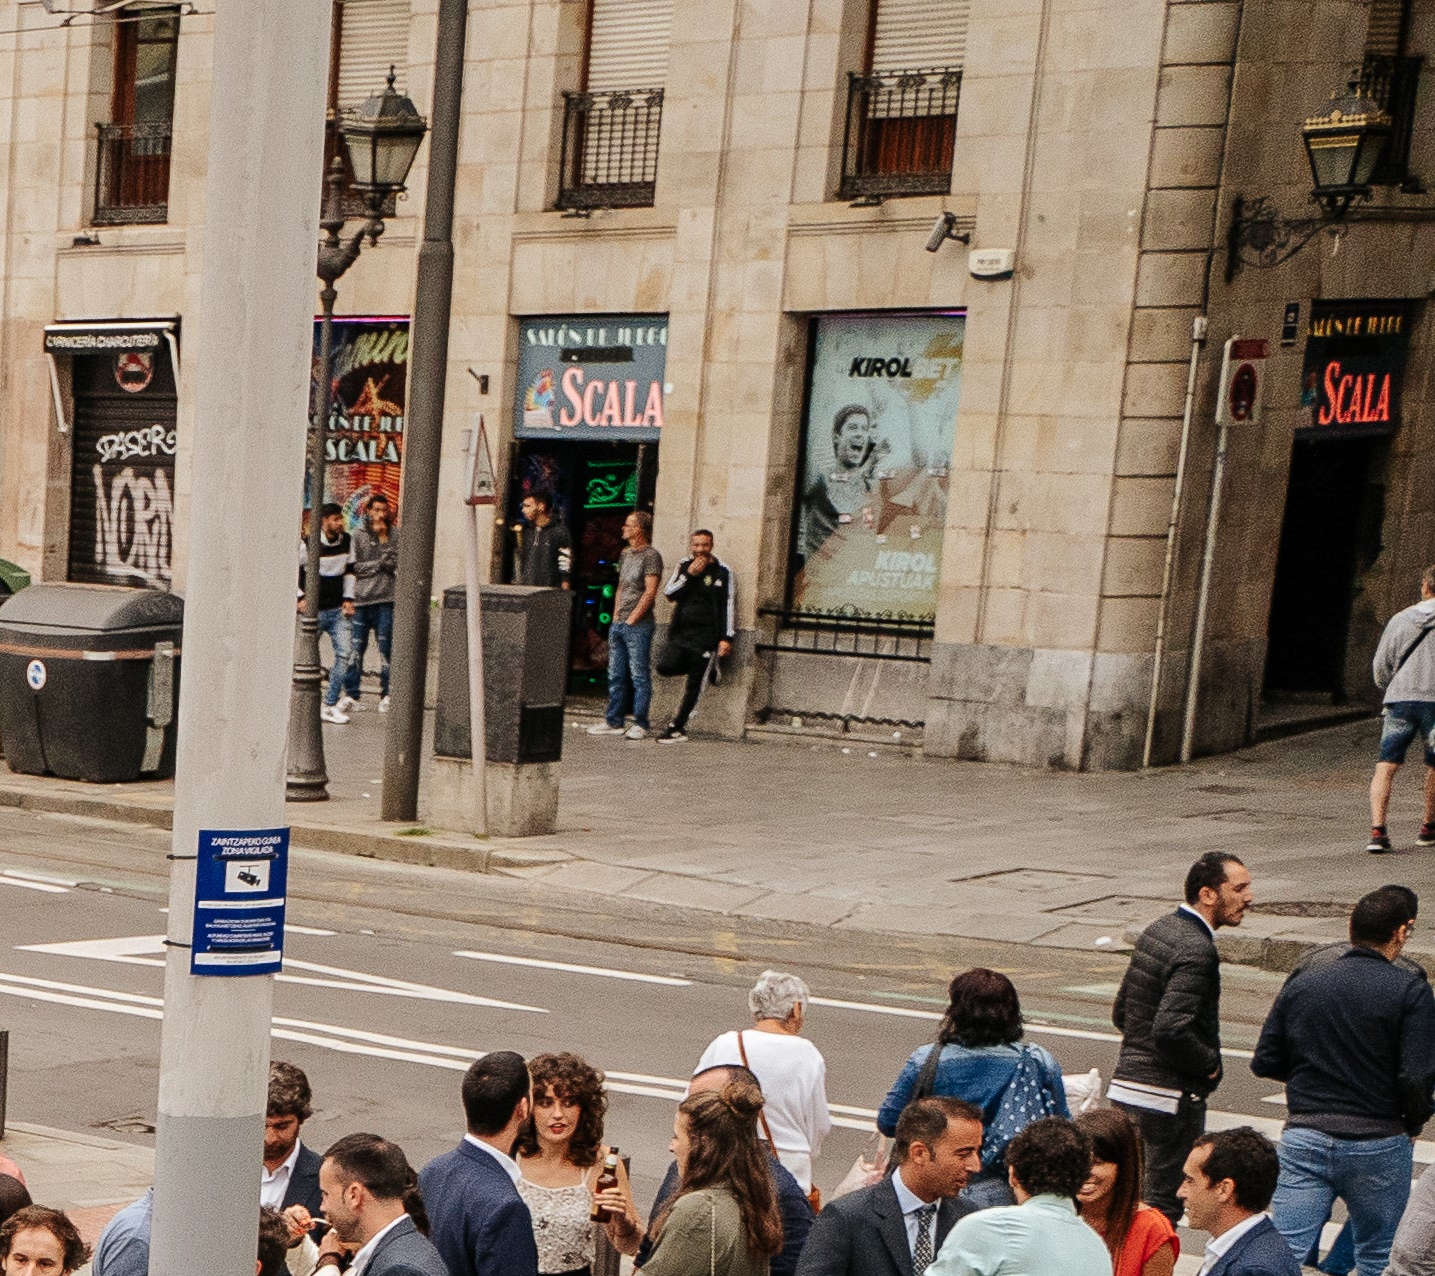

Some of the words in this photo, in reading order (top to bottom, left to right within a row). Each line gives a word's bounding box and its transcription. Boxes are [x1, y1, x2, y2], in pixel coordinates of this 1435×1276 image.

[559, 366, 665, 428] SCALA
[1318, 360, 1392, 426] SCALA
[324, 437, 400, 463] SCALA
